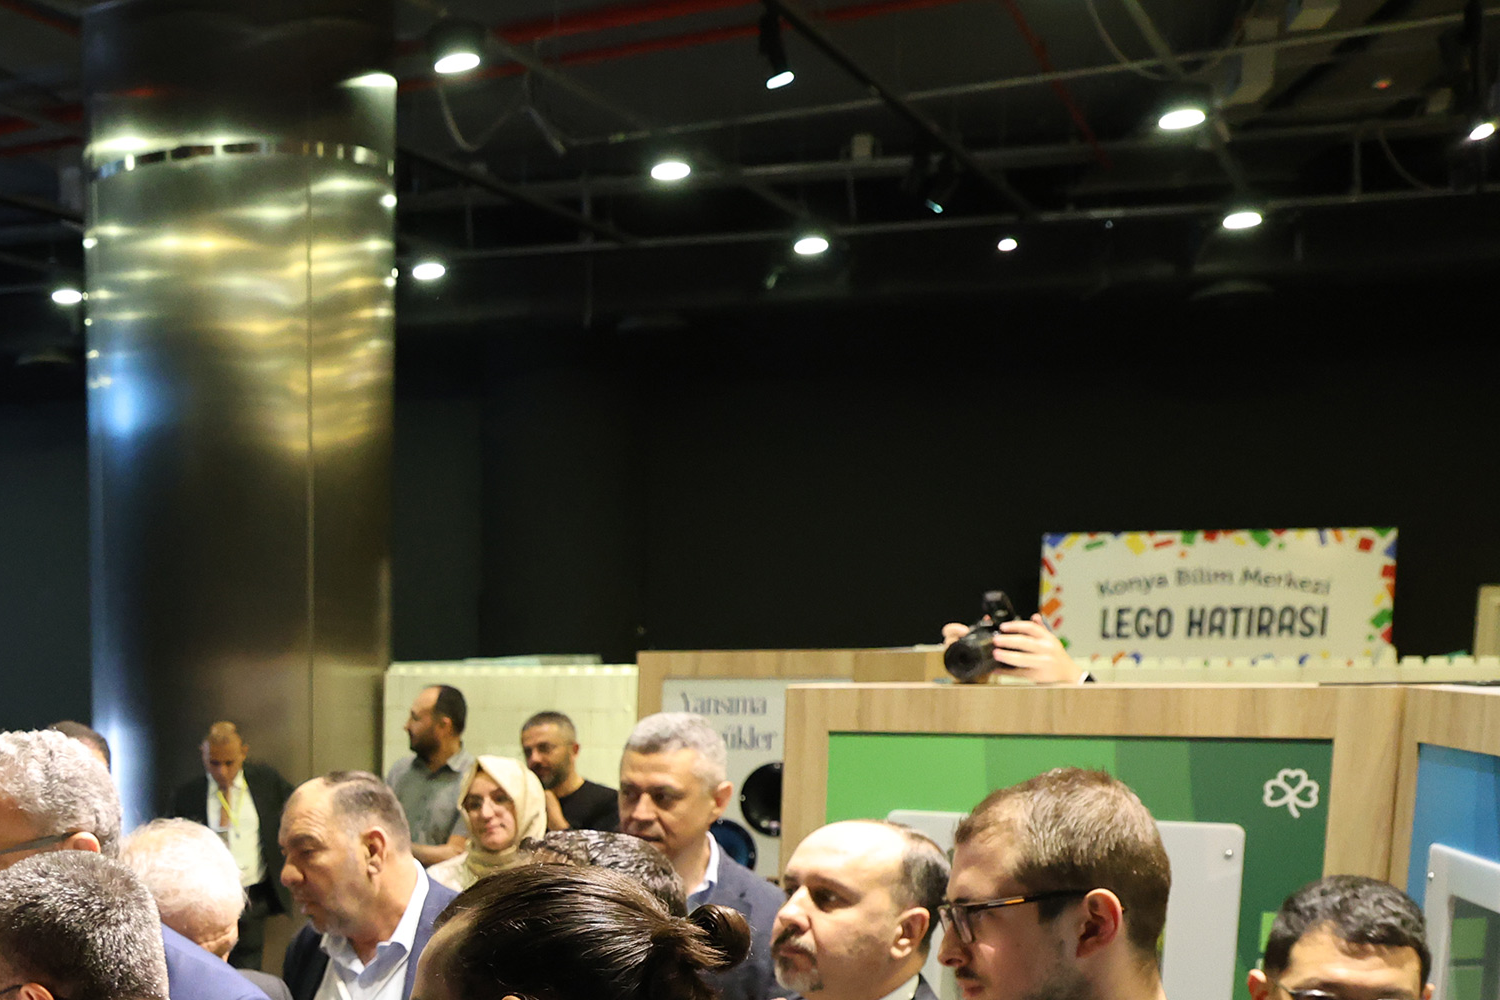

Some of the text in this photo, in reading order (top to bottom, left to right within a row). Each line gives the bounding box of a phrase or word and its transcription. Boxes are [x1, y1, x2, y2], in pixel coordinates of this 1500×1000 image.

[1098, 567, 1331, 596] Konya Bilim Merkezi
[1101, 605, 1329, 639] LEGO HATIRASI
